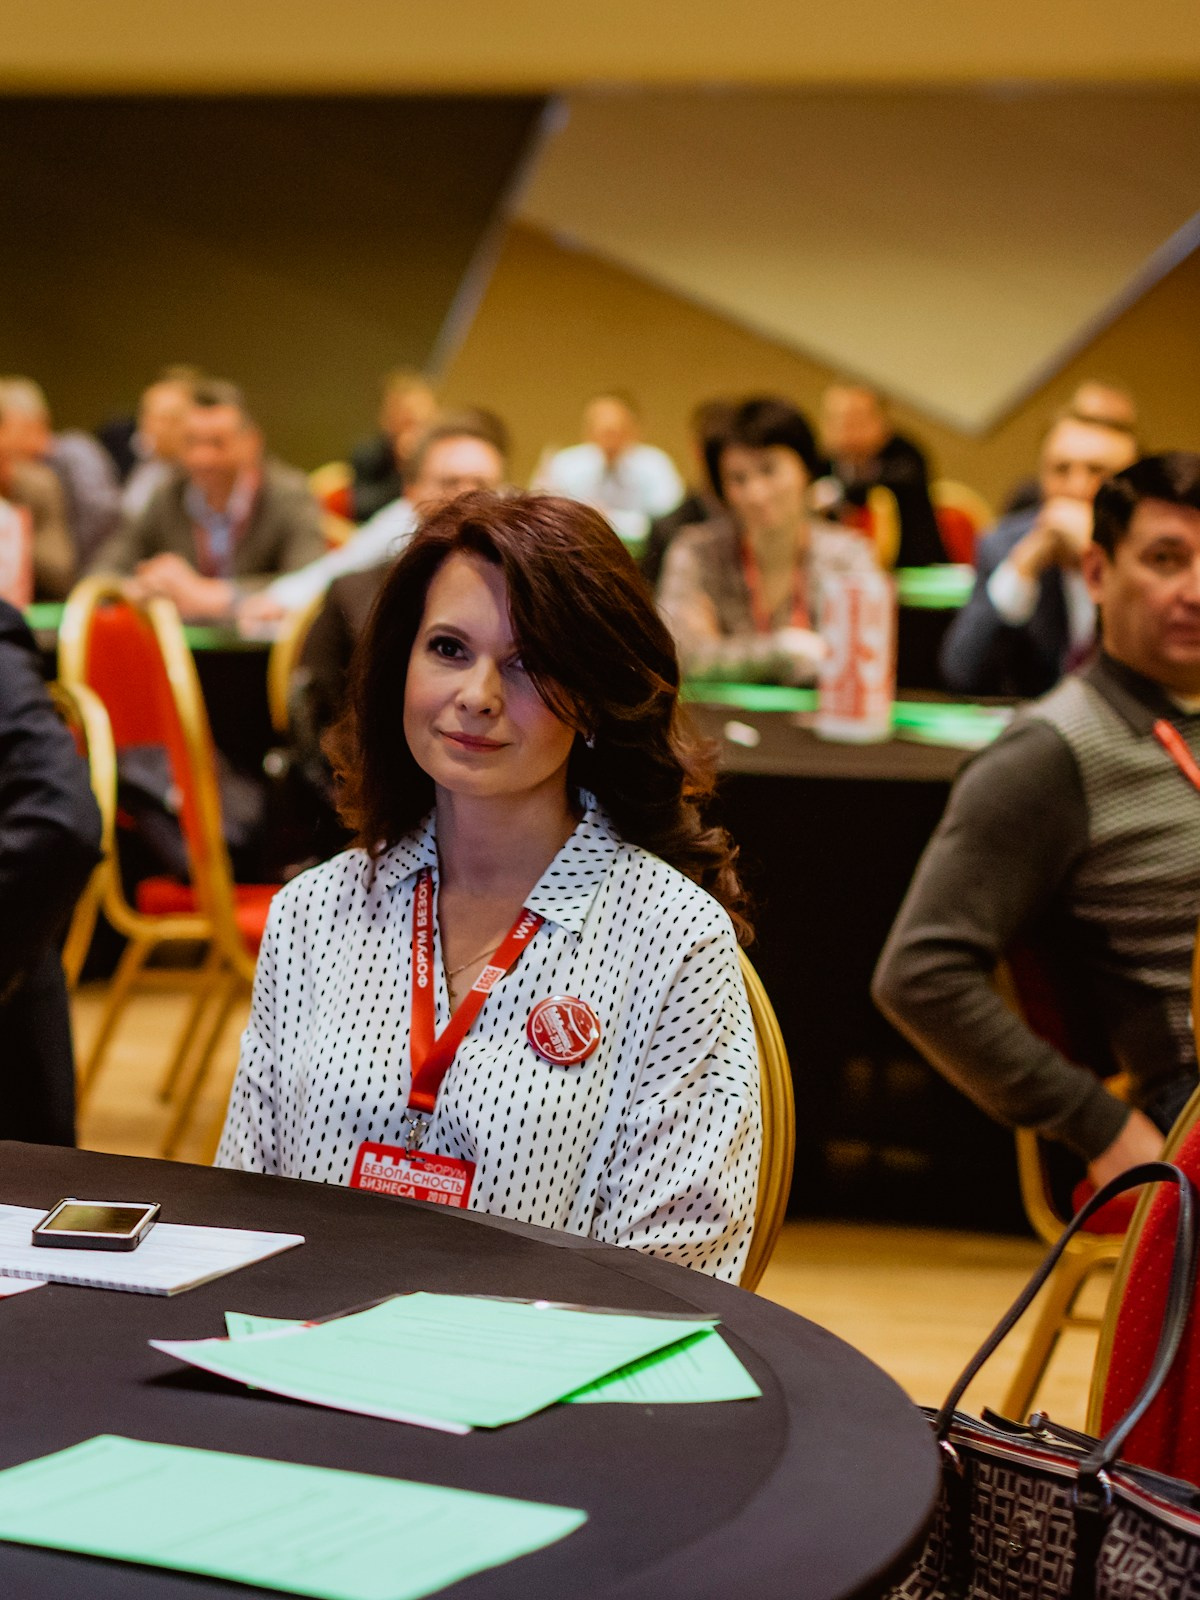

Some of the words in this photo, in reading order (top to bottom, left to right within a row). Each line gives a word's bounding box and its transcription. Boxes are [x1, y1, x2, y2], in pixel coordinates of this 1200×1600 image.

[416, 930, 429, 988] ФОРУМ
[363, 1162, 464, 1194] БЕЗОПАСНОСТЬ
[424, 1162, 467, 1180] ФОРУМ
[359, 1175, 416, 1199] БИЗНЕСА
